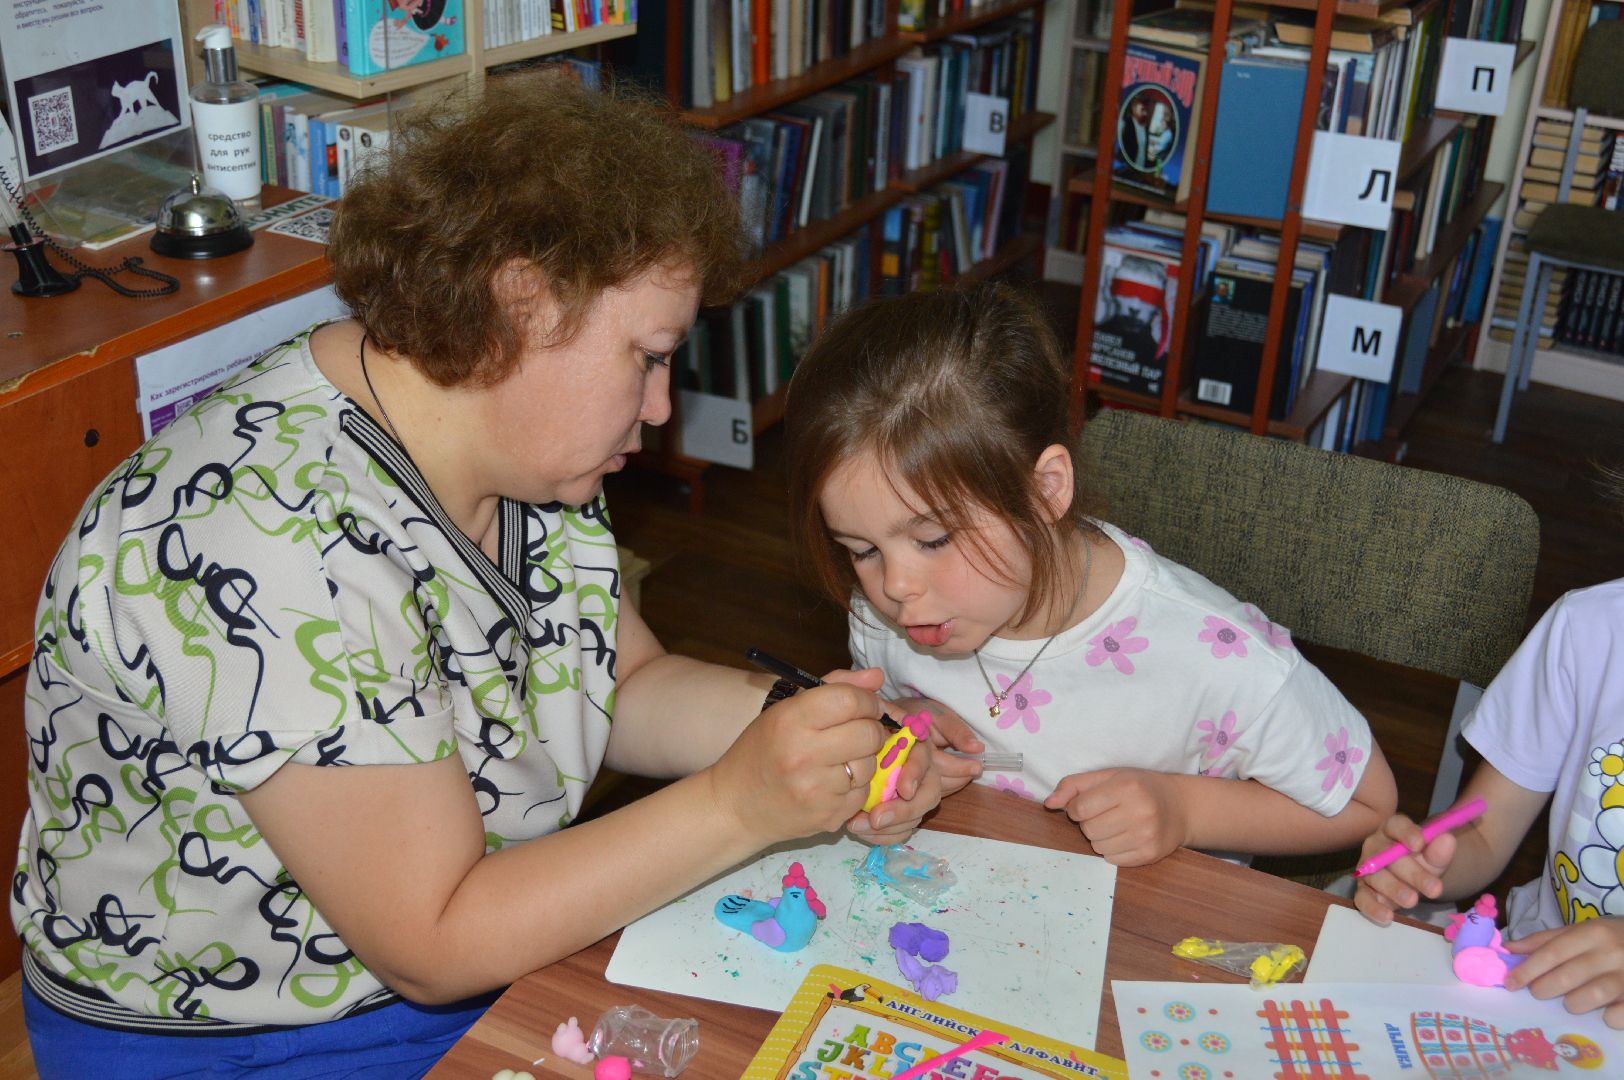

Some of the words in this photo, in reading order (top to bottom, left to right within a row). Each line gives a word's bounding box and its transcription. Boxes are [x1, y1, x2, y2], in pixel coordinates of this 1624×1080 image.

[1471, 66, 1495, 93] П
[990, 112, 1004, 132] В
[207, 131, 252, 142] средство
[211, 148, 229, 157] для
[1358, 168, 1391, 202] Л
[1352, 325, 1381, 357] М
[150, 392, 163, 401] Как
[165, 367, 226, 395] зарегистрировать
[731, 418, 749, 445] Б
[886, 1000, 1003, 1046] АНГЛИЙСК
[1009, 1043, 1099, 1076] АЛФАВИТ
